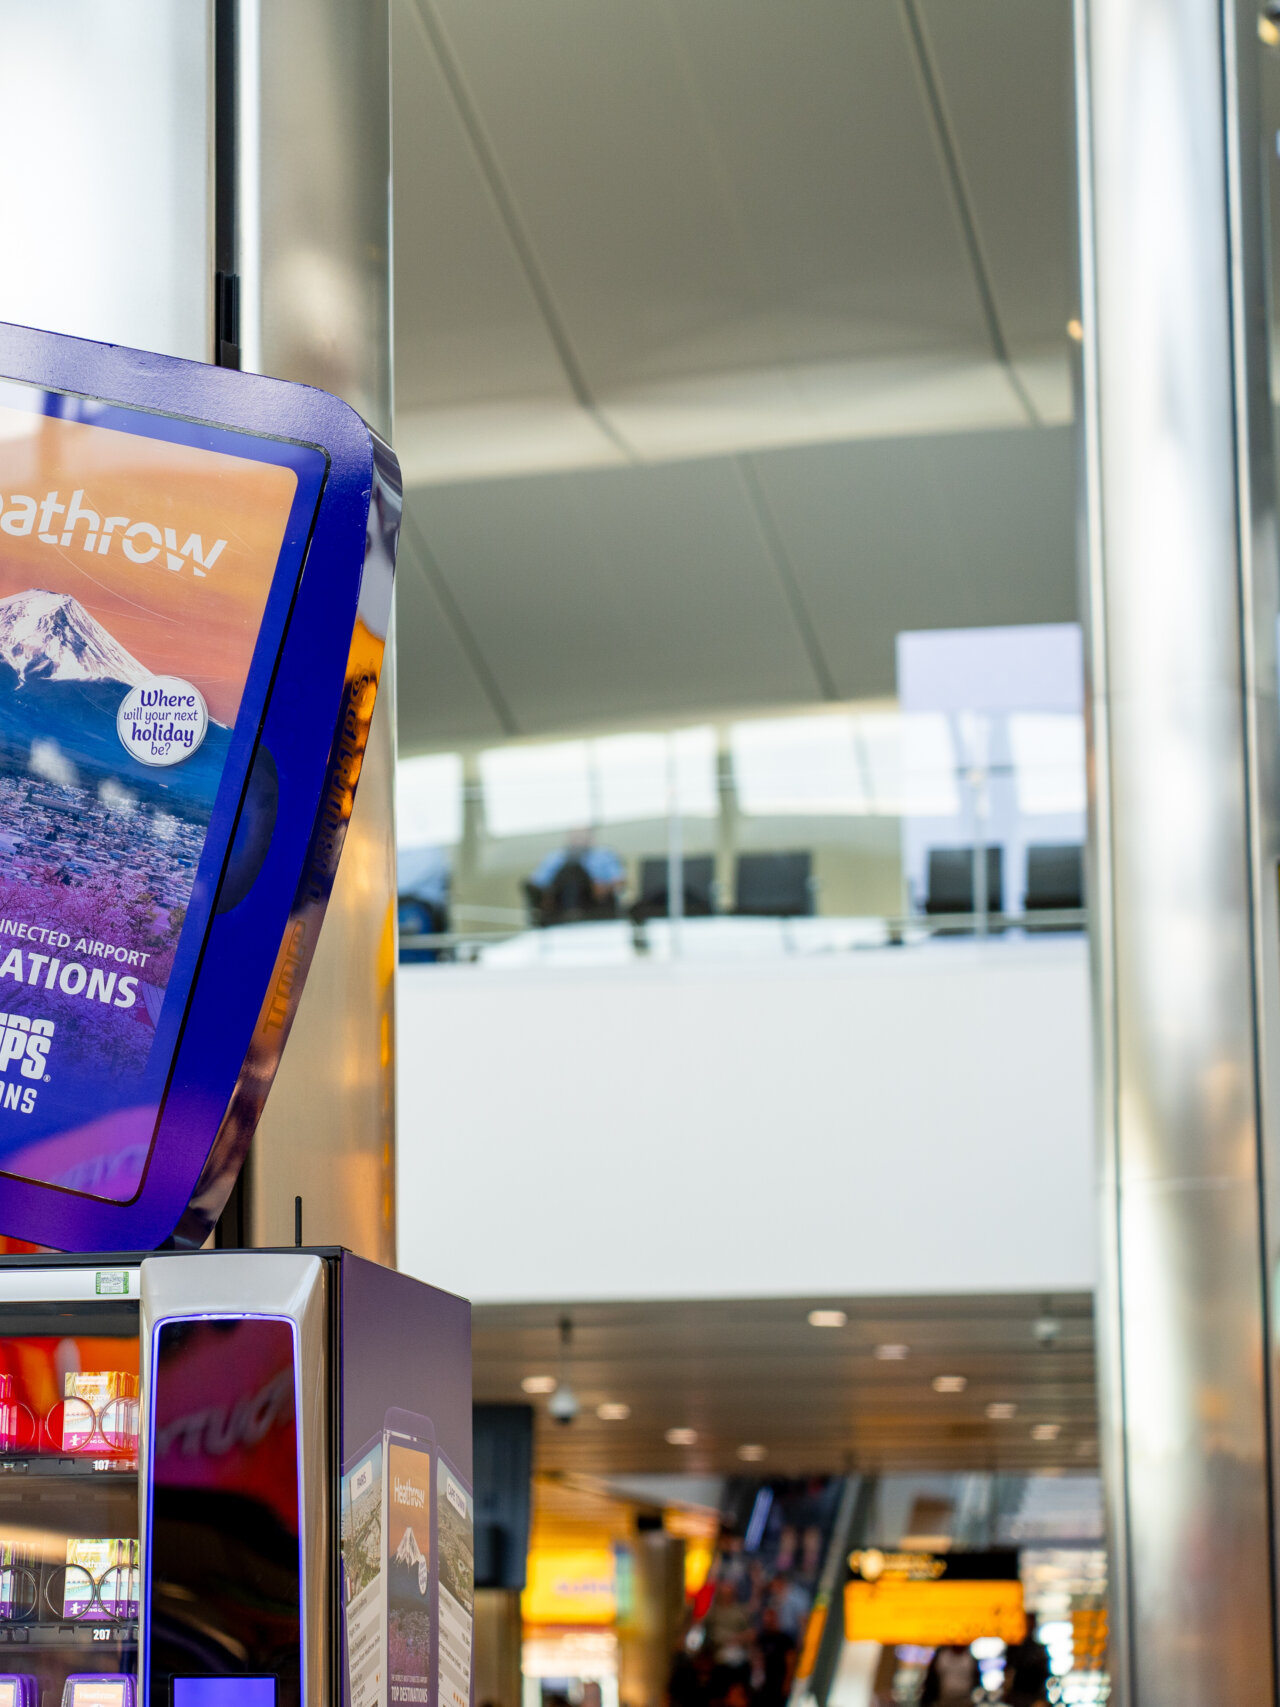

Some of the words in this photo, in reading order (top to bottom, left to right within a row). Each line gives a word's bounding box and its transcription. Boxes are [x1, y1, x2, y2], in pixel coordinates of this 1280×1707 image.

[140, 688, 195, 707] Where
[123, 706, 143, 721] will
[144, 711, 171, 725] your
[173, 709, 199, 721] next
[131, 721, 194, 748] holiday
[150, 741, 171, 756] be?
[73, 937, 151, 968] AIRPORT
[93, 1459, 110, 1471] 107
[393, 1476, 426, 1509] Heathrow
[93, 1628, 111, 1640] 207
